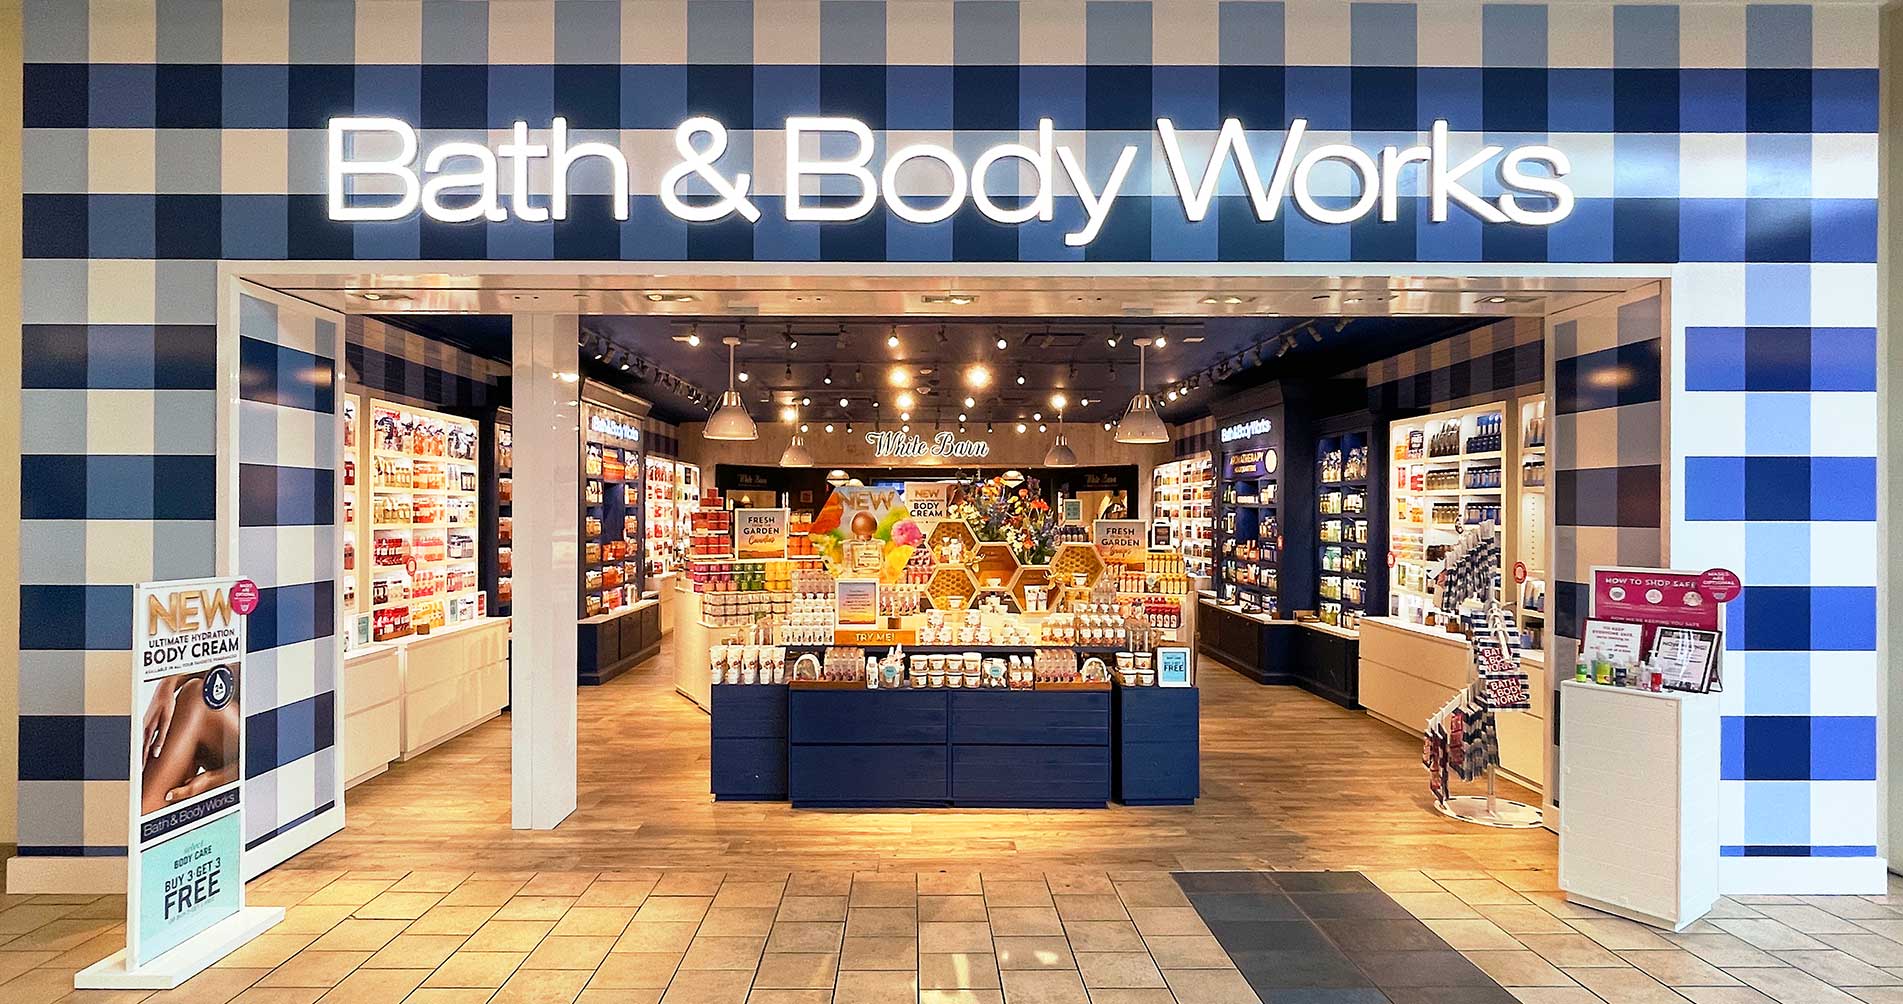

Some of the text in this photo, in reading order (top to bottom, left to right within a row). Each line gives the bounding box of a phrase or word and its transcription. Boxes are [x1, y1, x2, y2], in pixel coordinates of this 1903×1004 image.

[326, 115, 1576, 247] Bath & Body Works
[865, 431, 990, 458] White Barn
[914, 489, 940, 499] NEW
[839, 490, 897, 511] NEW
[913, 502, 940, 510] BODY
[909, 509, 943, 518] CREAM
[747, 516, 775, 524] FRESH
[743, 527, 780, 535] GARDEN
[1106, 527, 1135, 536] FRESH
[1101, 538, 1140, 547] GARDEN
[1645, 579, 1670, 587] SHOP
[1672, 581, 1697, 589] SAFE
[148, 588, 233, 637] NEW
[149, 628, 235, 648] ULTIMATE HYDRATION
[855, 632, 896, 641] TRY ME!
[144, 637, 240, 667] BODY CREAM
[1484, 648, 1502, 657] BAT
[1164, 664, 1184, 672] FREE
[1491, 678, 1517, 690] BATH
[1497, 685, 1521, 697] BODY
[143, 794, 235, 837] Bath & Body Works
[174, 845, 212, 870] BODY CARE
[165, 874, 185, 893] BUY
[214, 857, 221, 869] 3
[165, 869, 221, 920] FREE
